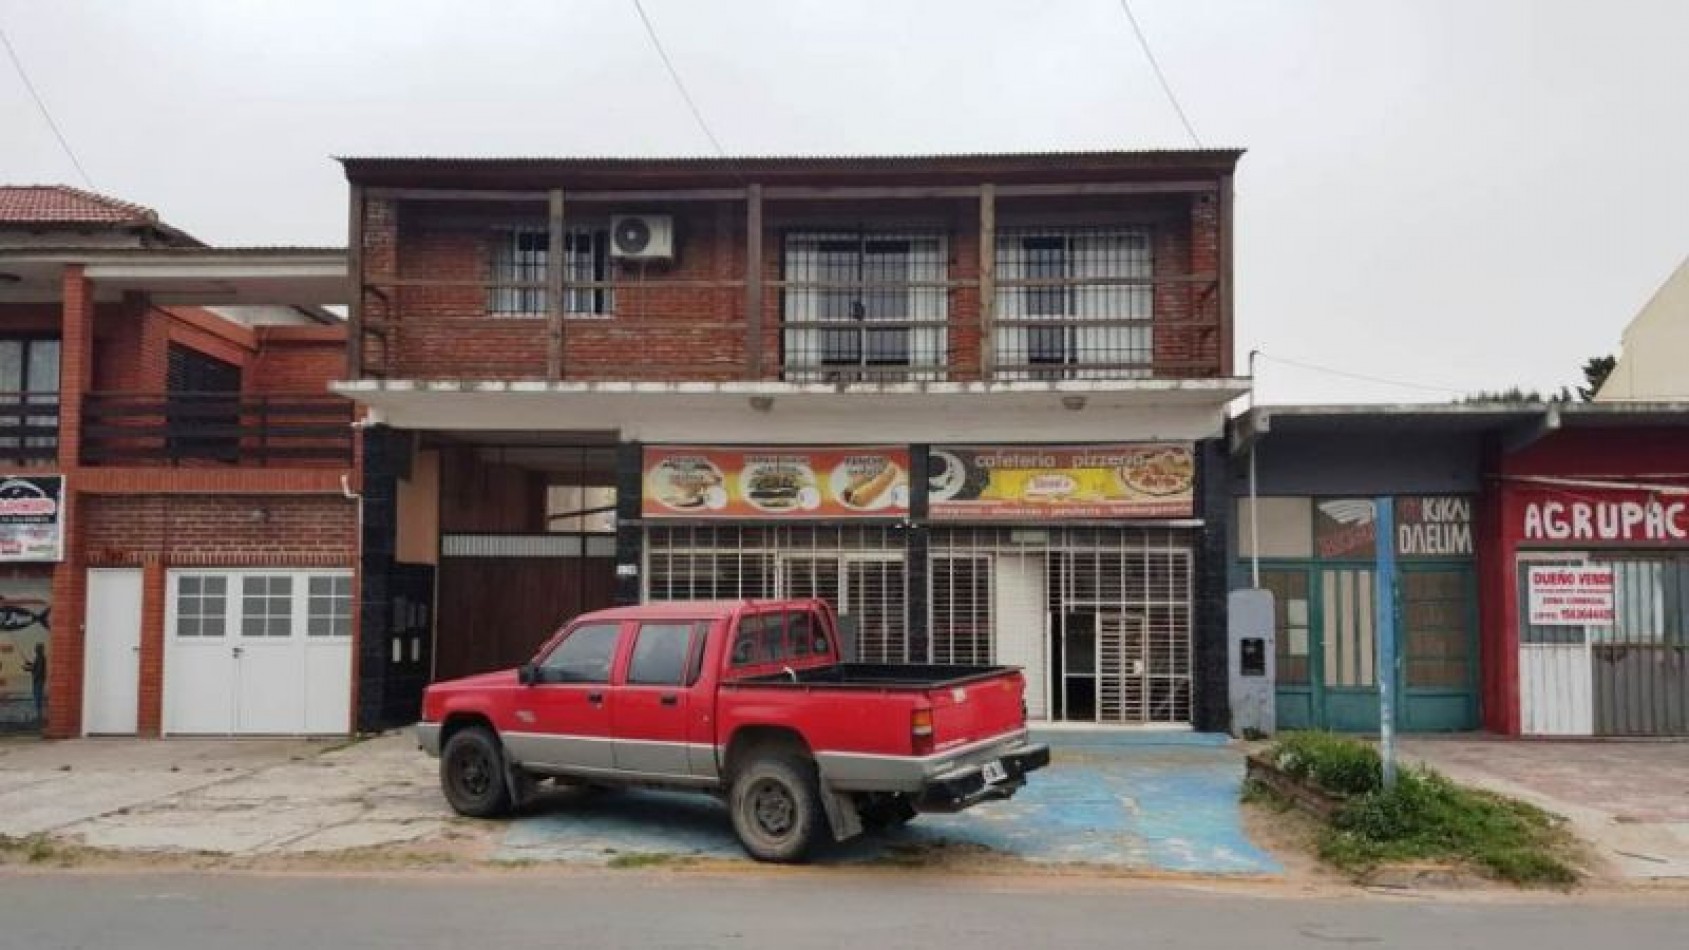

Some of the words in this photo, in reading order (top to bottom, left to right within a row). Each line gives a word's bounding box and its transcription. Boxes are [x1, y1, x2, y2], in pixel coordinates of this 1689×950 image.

[1524, 501, 1688, 540] AGRUPAC
[1401, 523, 1473, 554] DAELIM
[1534, 570, 1575, 585] DUEÑO
